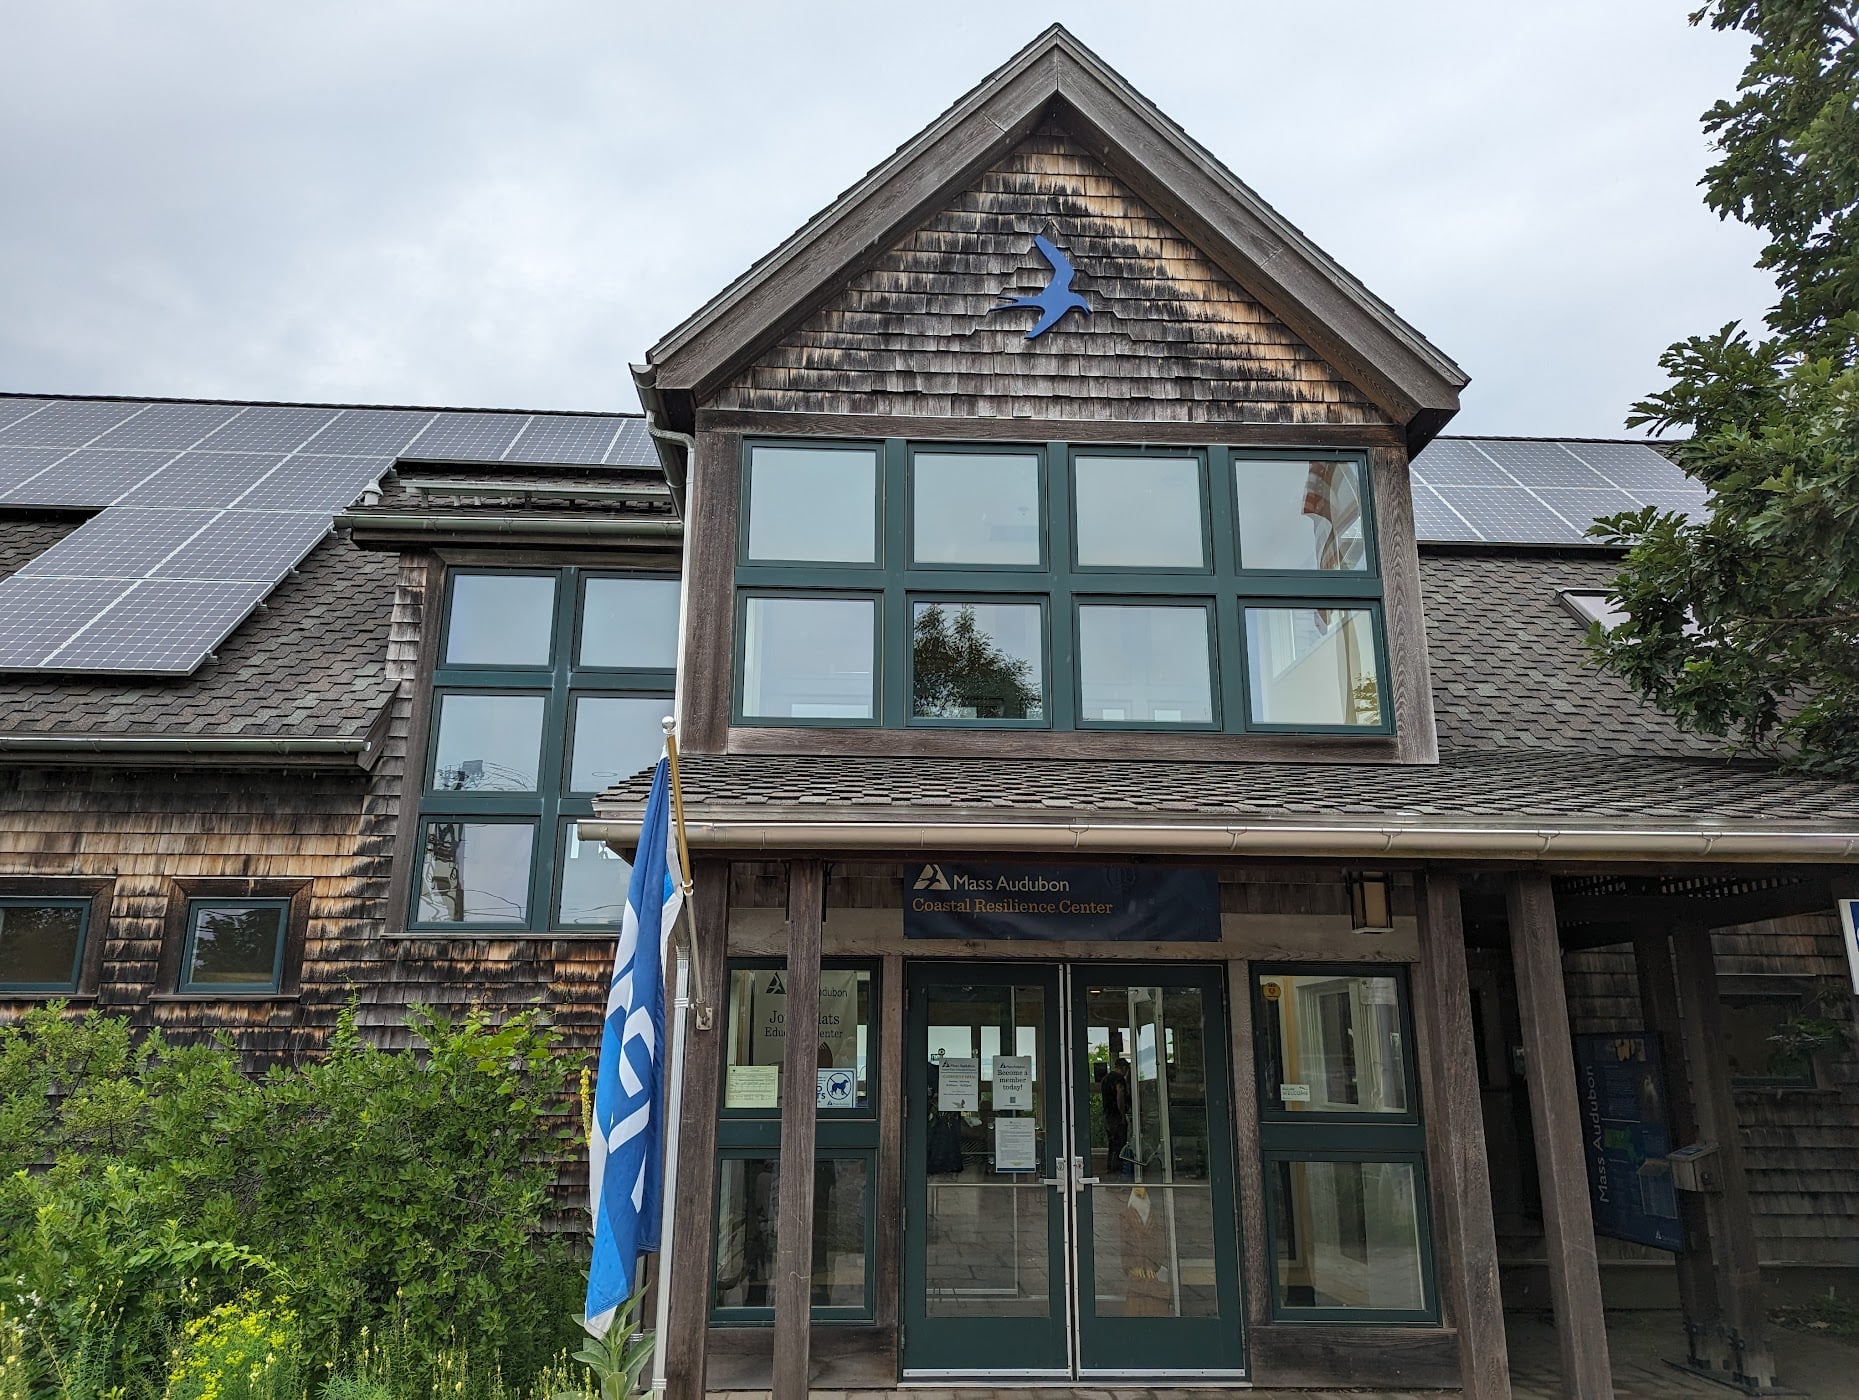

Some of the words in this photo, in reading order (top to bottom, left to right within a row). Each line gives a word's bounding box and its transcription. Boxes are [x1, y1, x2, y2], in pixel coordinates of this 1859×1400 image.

[953, 874, 993, 891] Mass
[996, 875, 1069, 892] Audubon
[912, 898, 971, 913] Coastal
[974, 898, 1056, 914] Resilience
[1059, 900, 1113, 914] Center
[819, 986, 848, 998] dubon
[819, 1030, 843, 1038] enter
[1002, 1084, 1023, 1092] today!
[1584, 1065, 1604, 1153] Audubon
[1597, 1157, 1610, 1203] Mass
